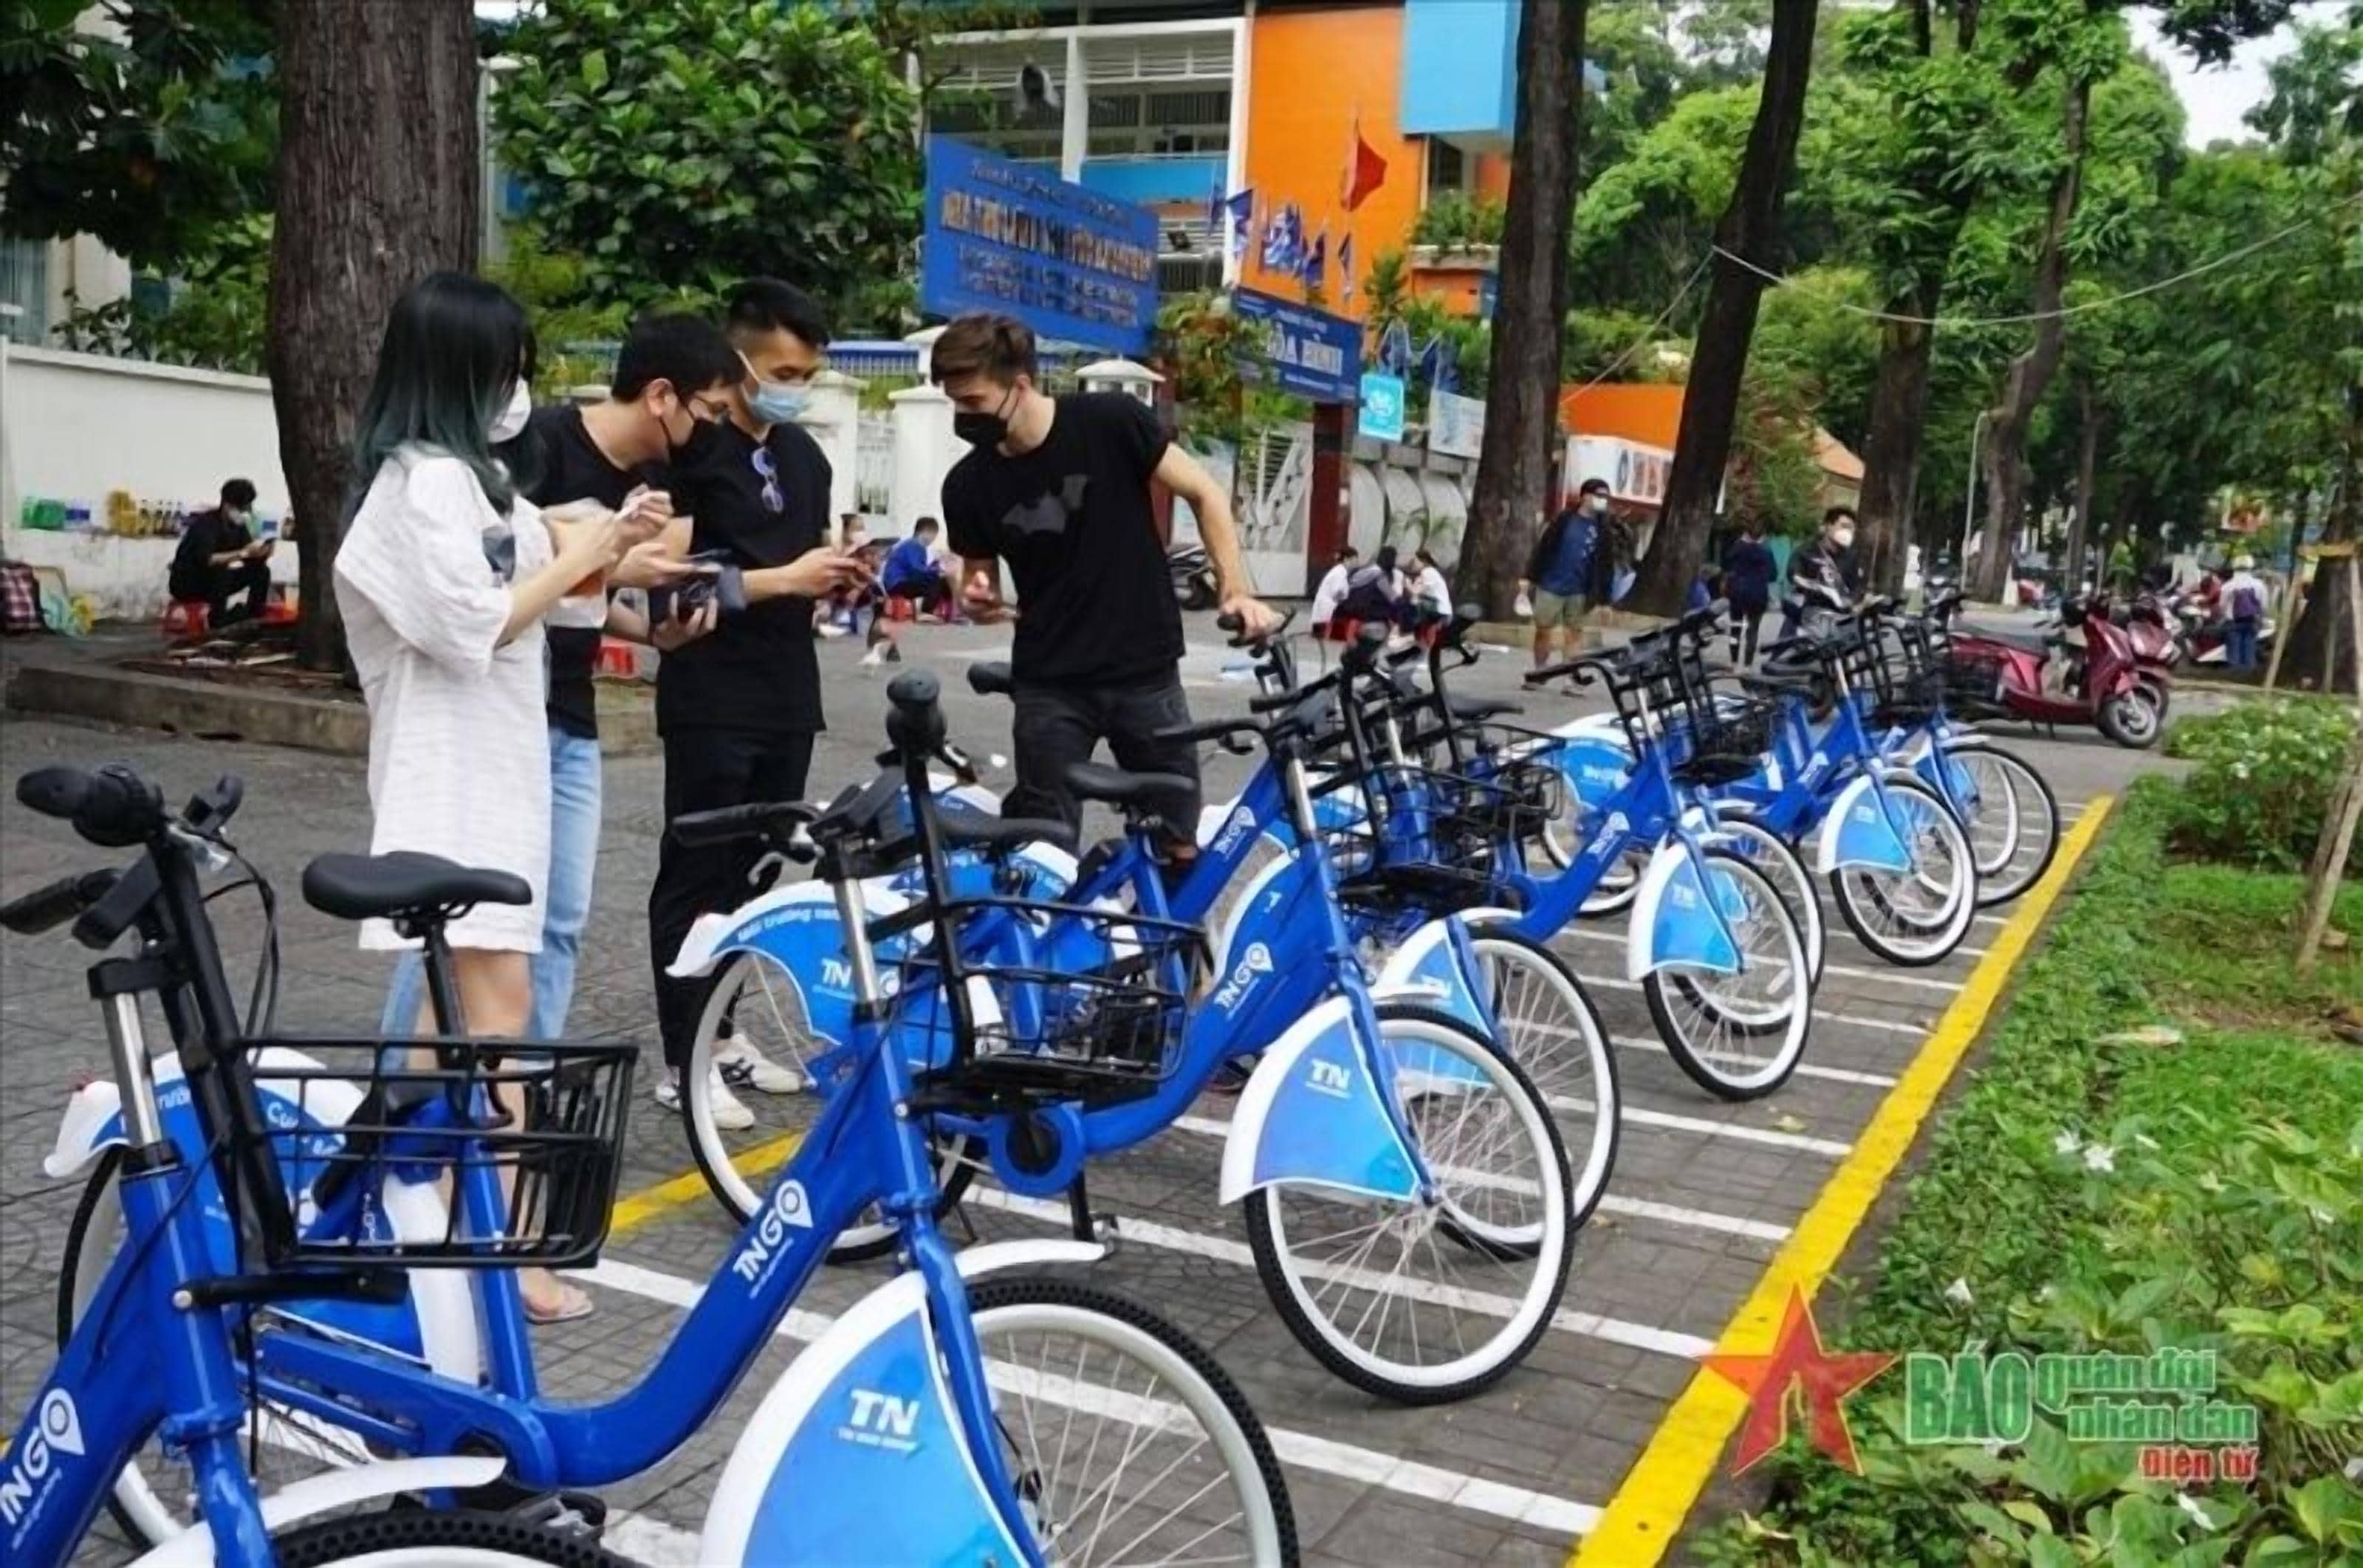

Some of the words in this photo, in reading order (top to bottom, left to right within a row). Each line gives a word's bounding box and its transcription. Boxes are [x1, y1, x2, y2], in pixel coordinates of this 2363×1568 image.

[1213, 941, 1275, 1009] TNGO
[1311, 1058, 1351, 1090] TN
[733, 1179, 813, 1281] TNGO
[851, 1389, 920, 1435] TN
